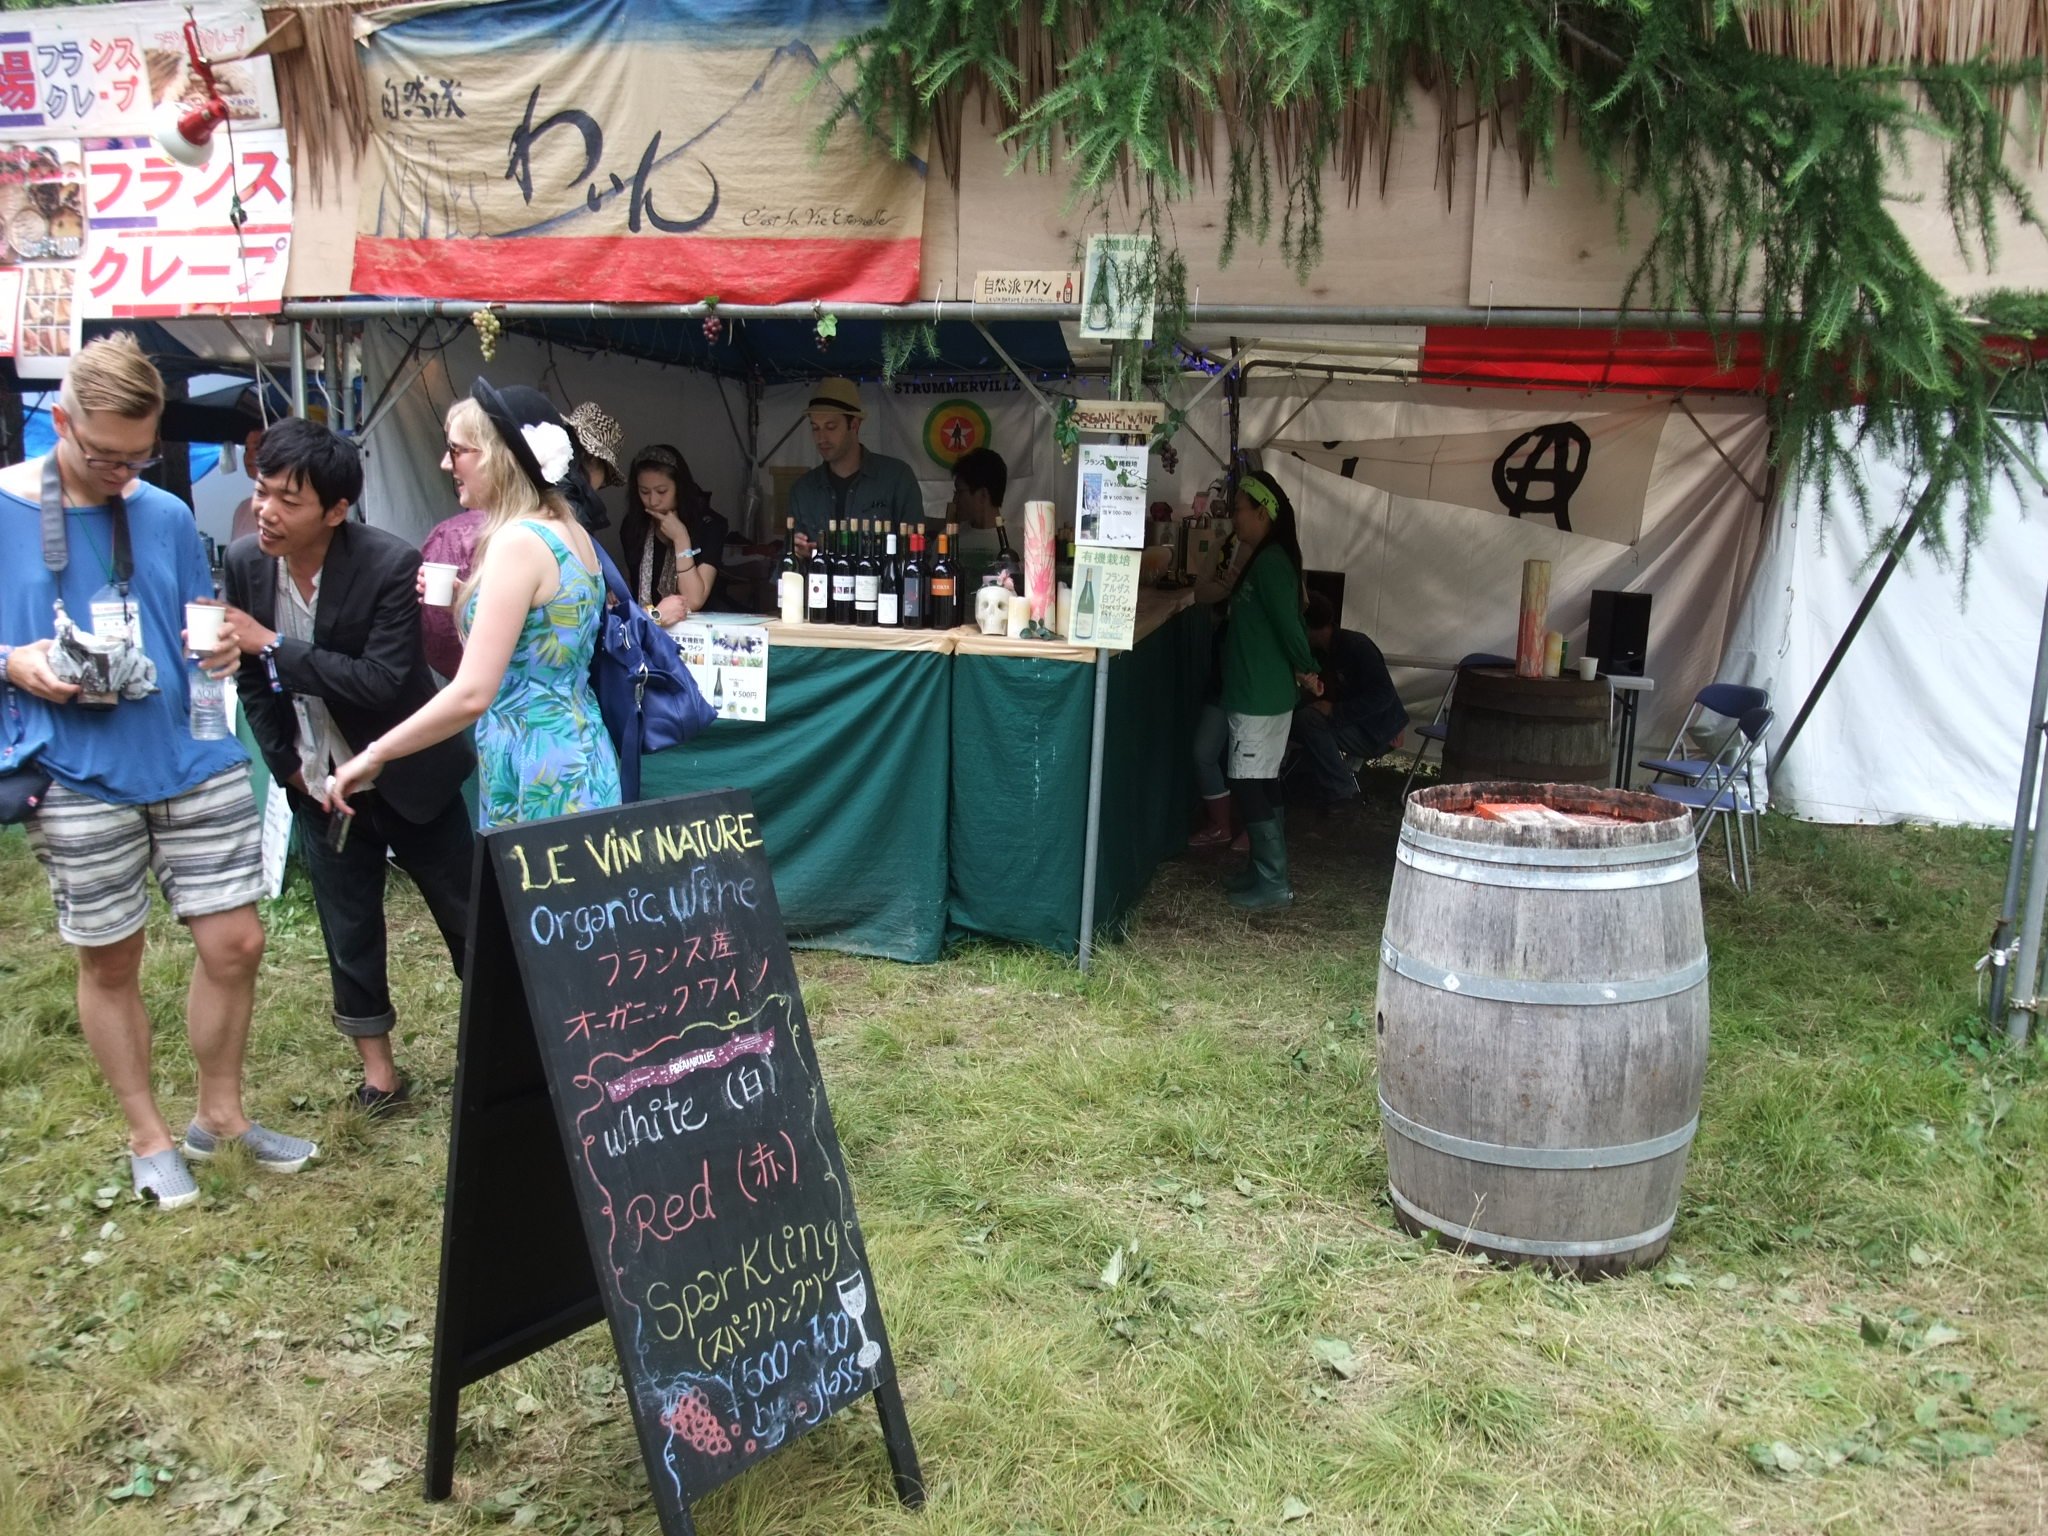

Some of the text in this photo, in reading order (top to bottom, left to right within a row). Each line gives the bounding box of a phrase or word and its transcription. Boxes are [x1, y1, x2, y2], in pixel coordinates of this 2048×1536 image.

[90, 151, 287, 213] フランス
[505, 83, 720, 233] わいん
[89, 236, 288, 298] クレープ
[894, 380, 1021, 394] STRUMMERVILLE
[512, 844, 576, 891] LE
[655, 814, 763, 864] NATURE
[531, 888, 666, 951] Organic
[626, 1159, 716, 1253] Red
